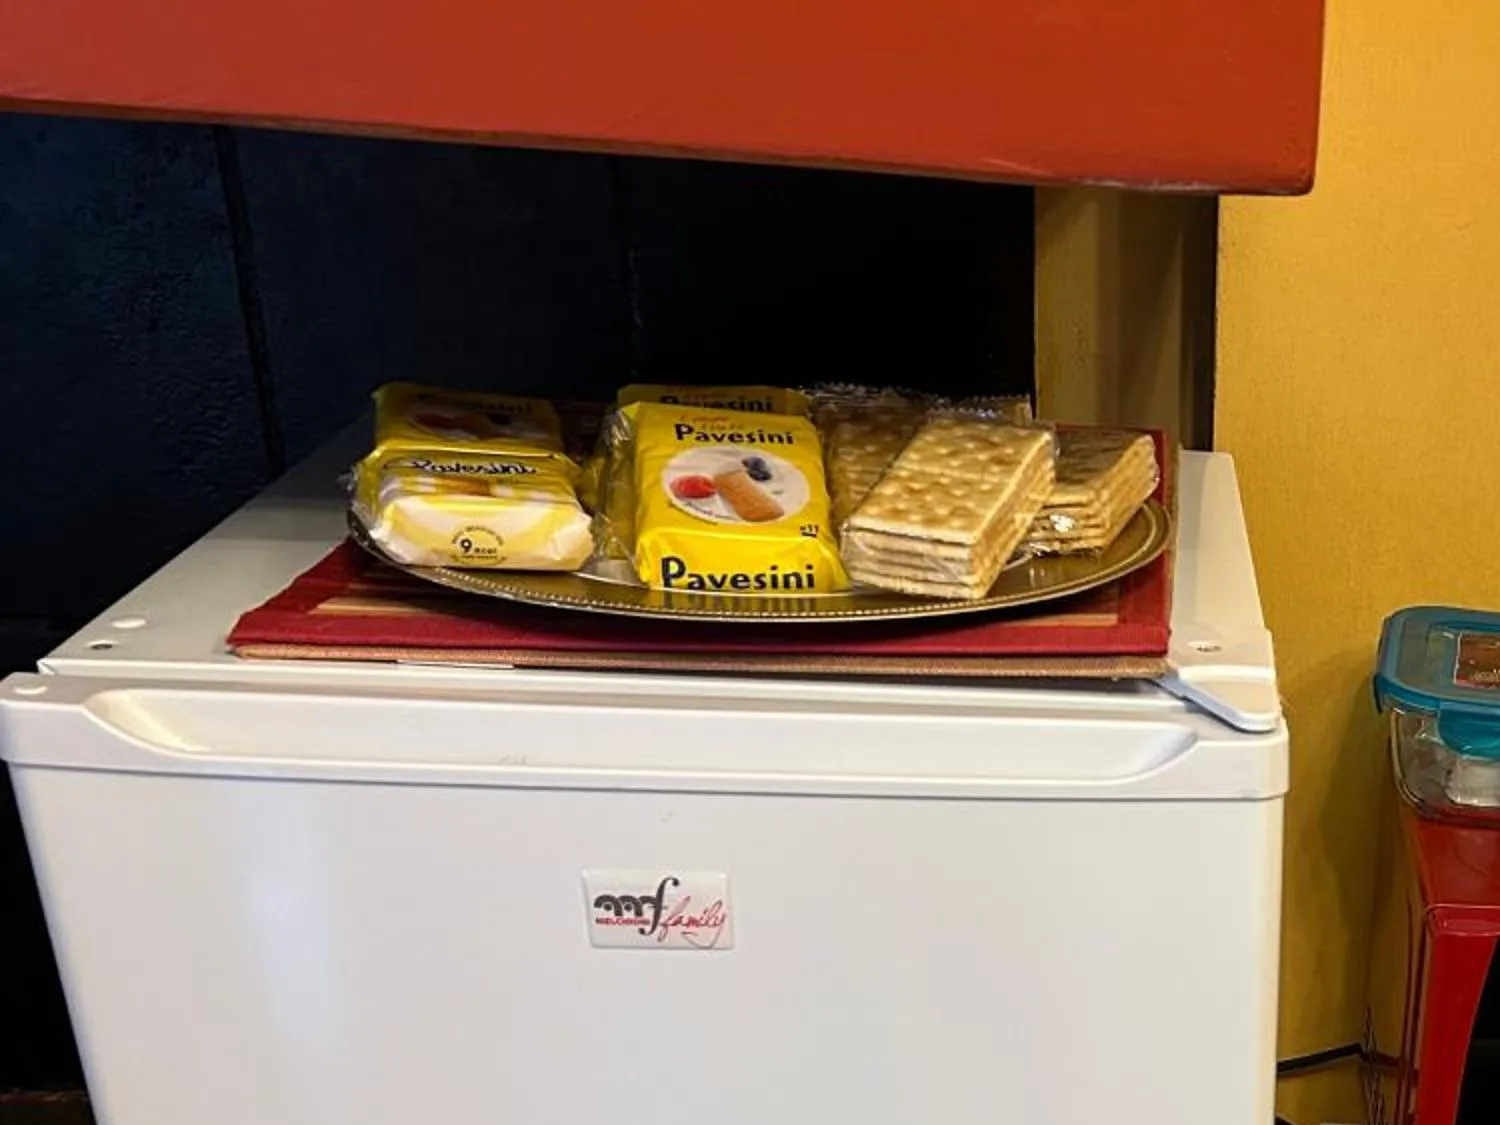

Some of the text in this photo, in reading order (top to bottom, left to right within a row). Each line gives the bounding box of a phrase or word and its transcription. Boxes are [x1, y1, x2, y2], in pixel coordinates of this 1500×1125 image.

[673, 423, 794, 445] Pavesini
[459, 538, 473, 553] 9
[660, 556, 816, 591] Pavesini
[656, 896, 727, 949] family
